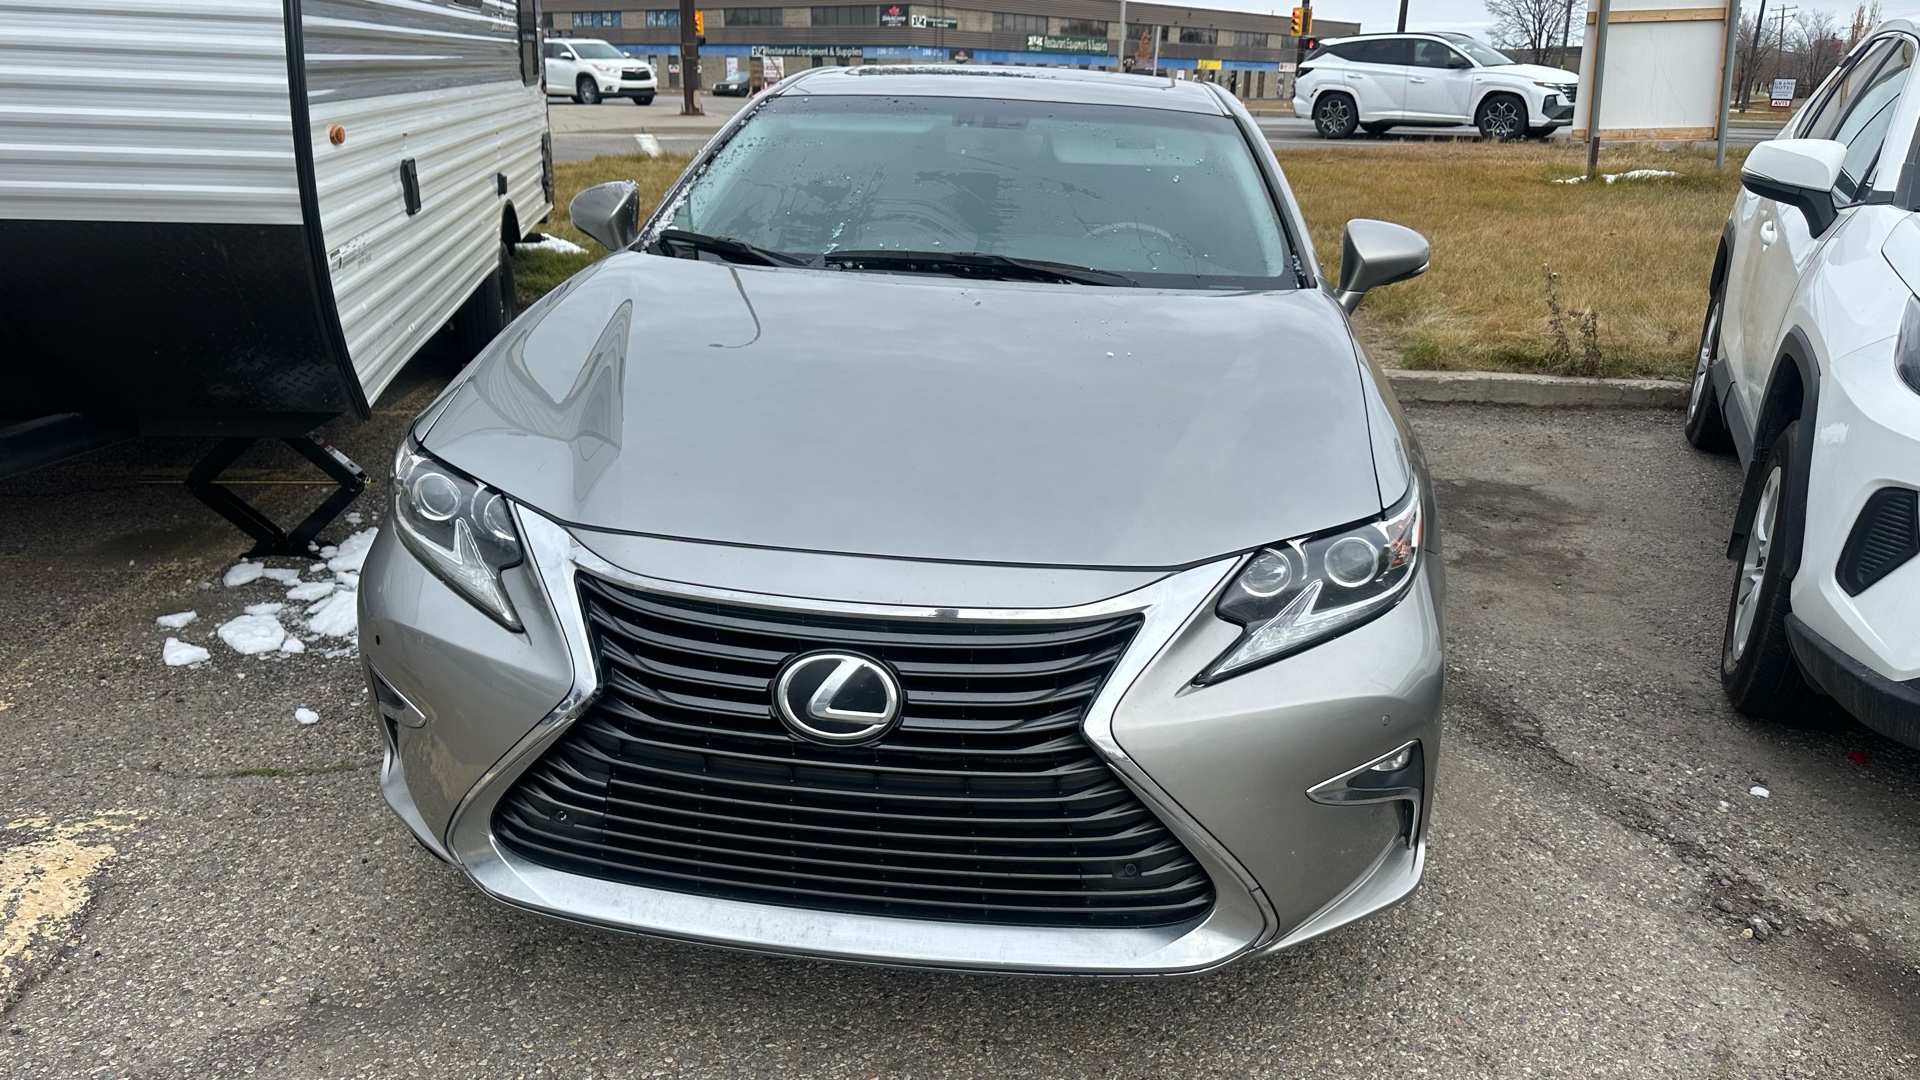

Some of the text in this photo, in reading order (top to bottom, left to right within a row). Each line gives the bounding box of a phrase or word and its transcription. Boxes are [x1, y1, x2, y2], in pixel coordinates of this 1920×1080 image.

[1044, 35, 1066, 49] Restaurant
[1067, 37, 1087, 51] Equipment
[1092, 39, 1108, 52] Supplies
[765, 46, 795, 56] Restaurant
[797, 46, 828, 57] Equipment
[829, 47, 834, 56] &
[836, 46, 862, 57] Supplies
